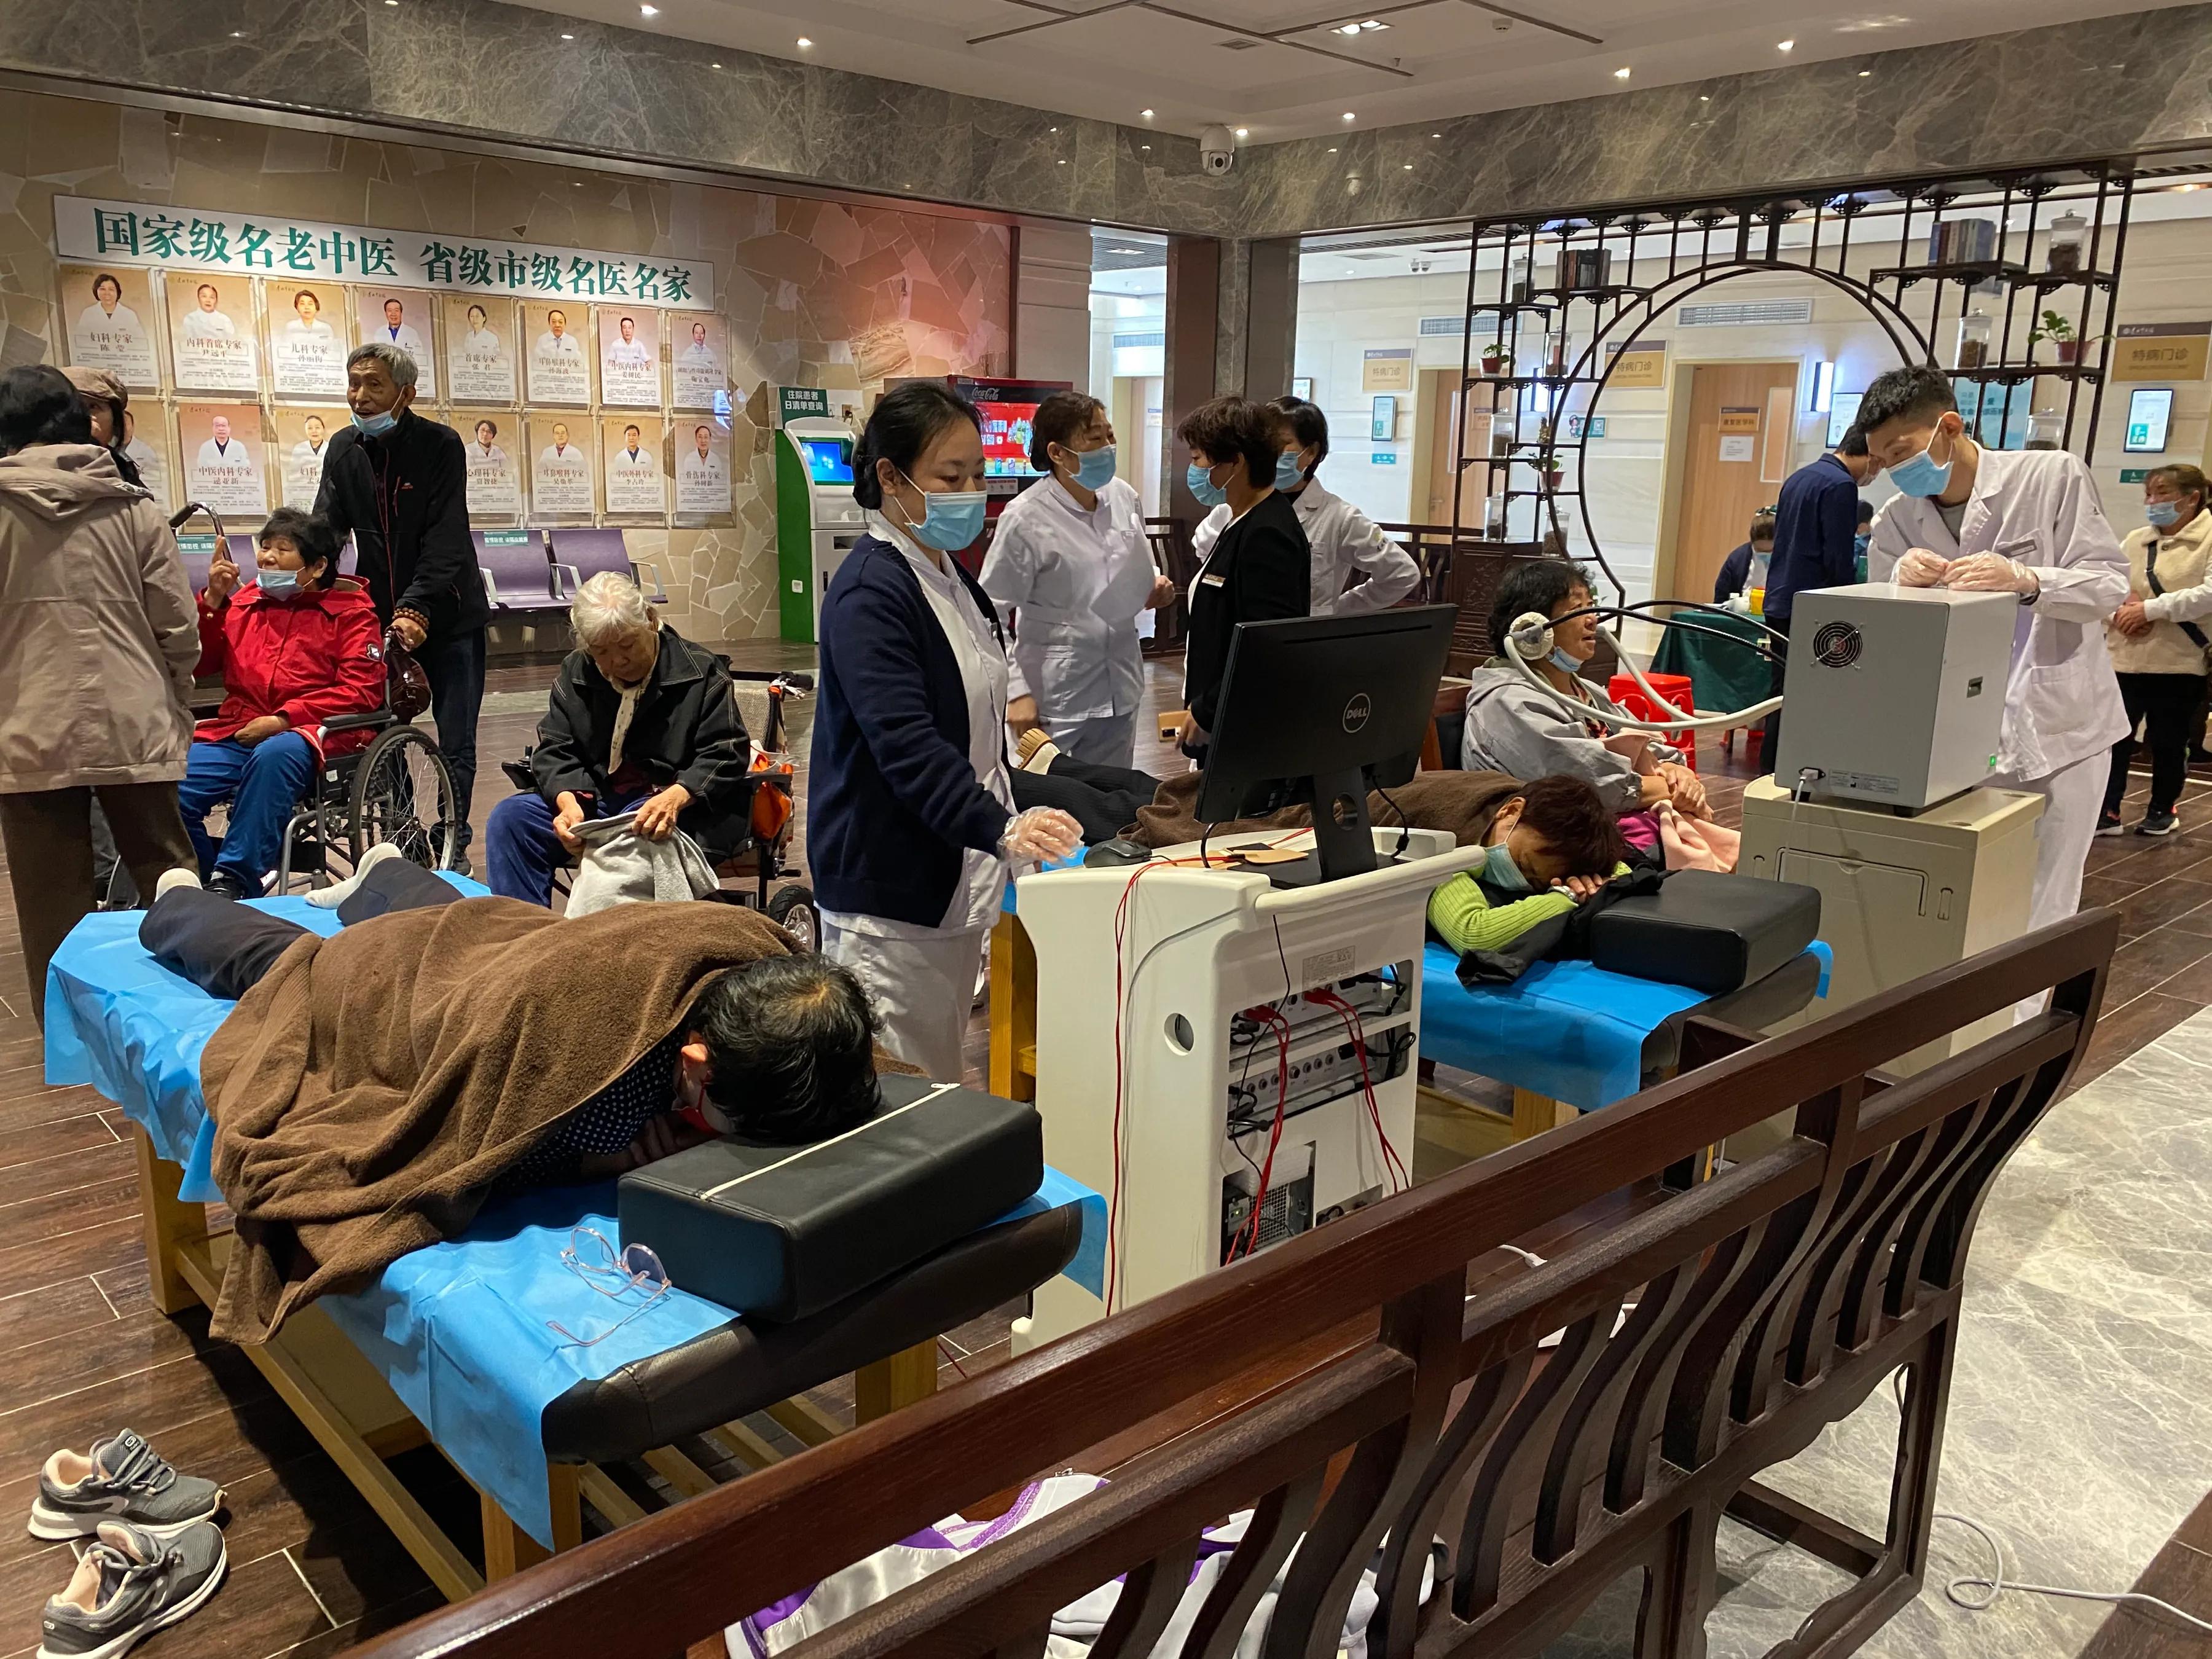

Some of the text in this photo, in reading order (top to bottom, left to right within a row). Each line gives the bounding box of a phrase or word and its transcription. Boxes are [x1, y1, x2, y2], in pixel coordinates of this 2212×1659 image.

[94, 208, 692, 302] 国家级名老中医 省级市级名医名家
[292, 342, 328, 354] 儿科专家
[2132, 348, 2189, 361] 特病门诊
[610, 363, 651, 371] 中医内科专家
[1372, 367, 1401, 376] 特病门诊
[1616, 361, 1652, 372] 特病门诊
[788, 390, 818, 400] 住院患者
[972, 387, 1000, 400] Coca-Cola
[785, 401, 823, 411] 日清单查询
[198, 467, 253, 476] 中医内科专家
[616, 469, 654, 478] 中医外科专家
[686, 471, 721, 480] 骨伤科专家
[1346, 707, 1367, 720] DELL
